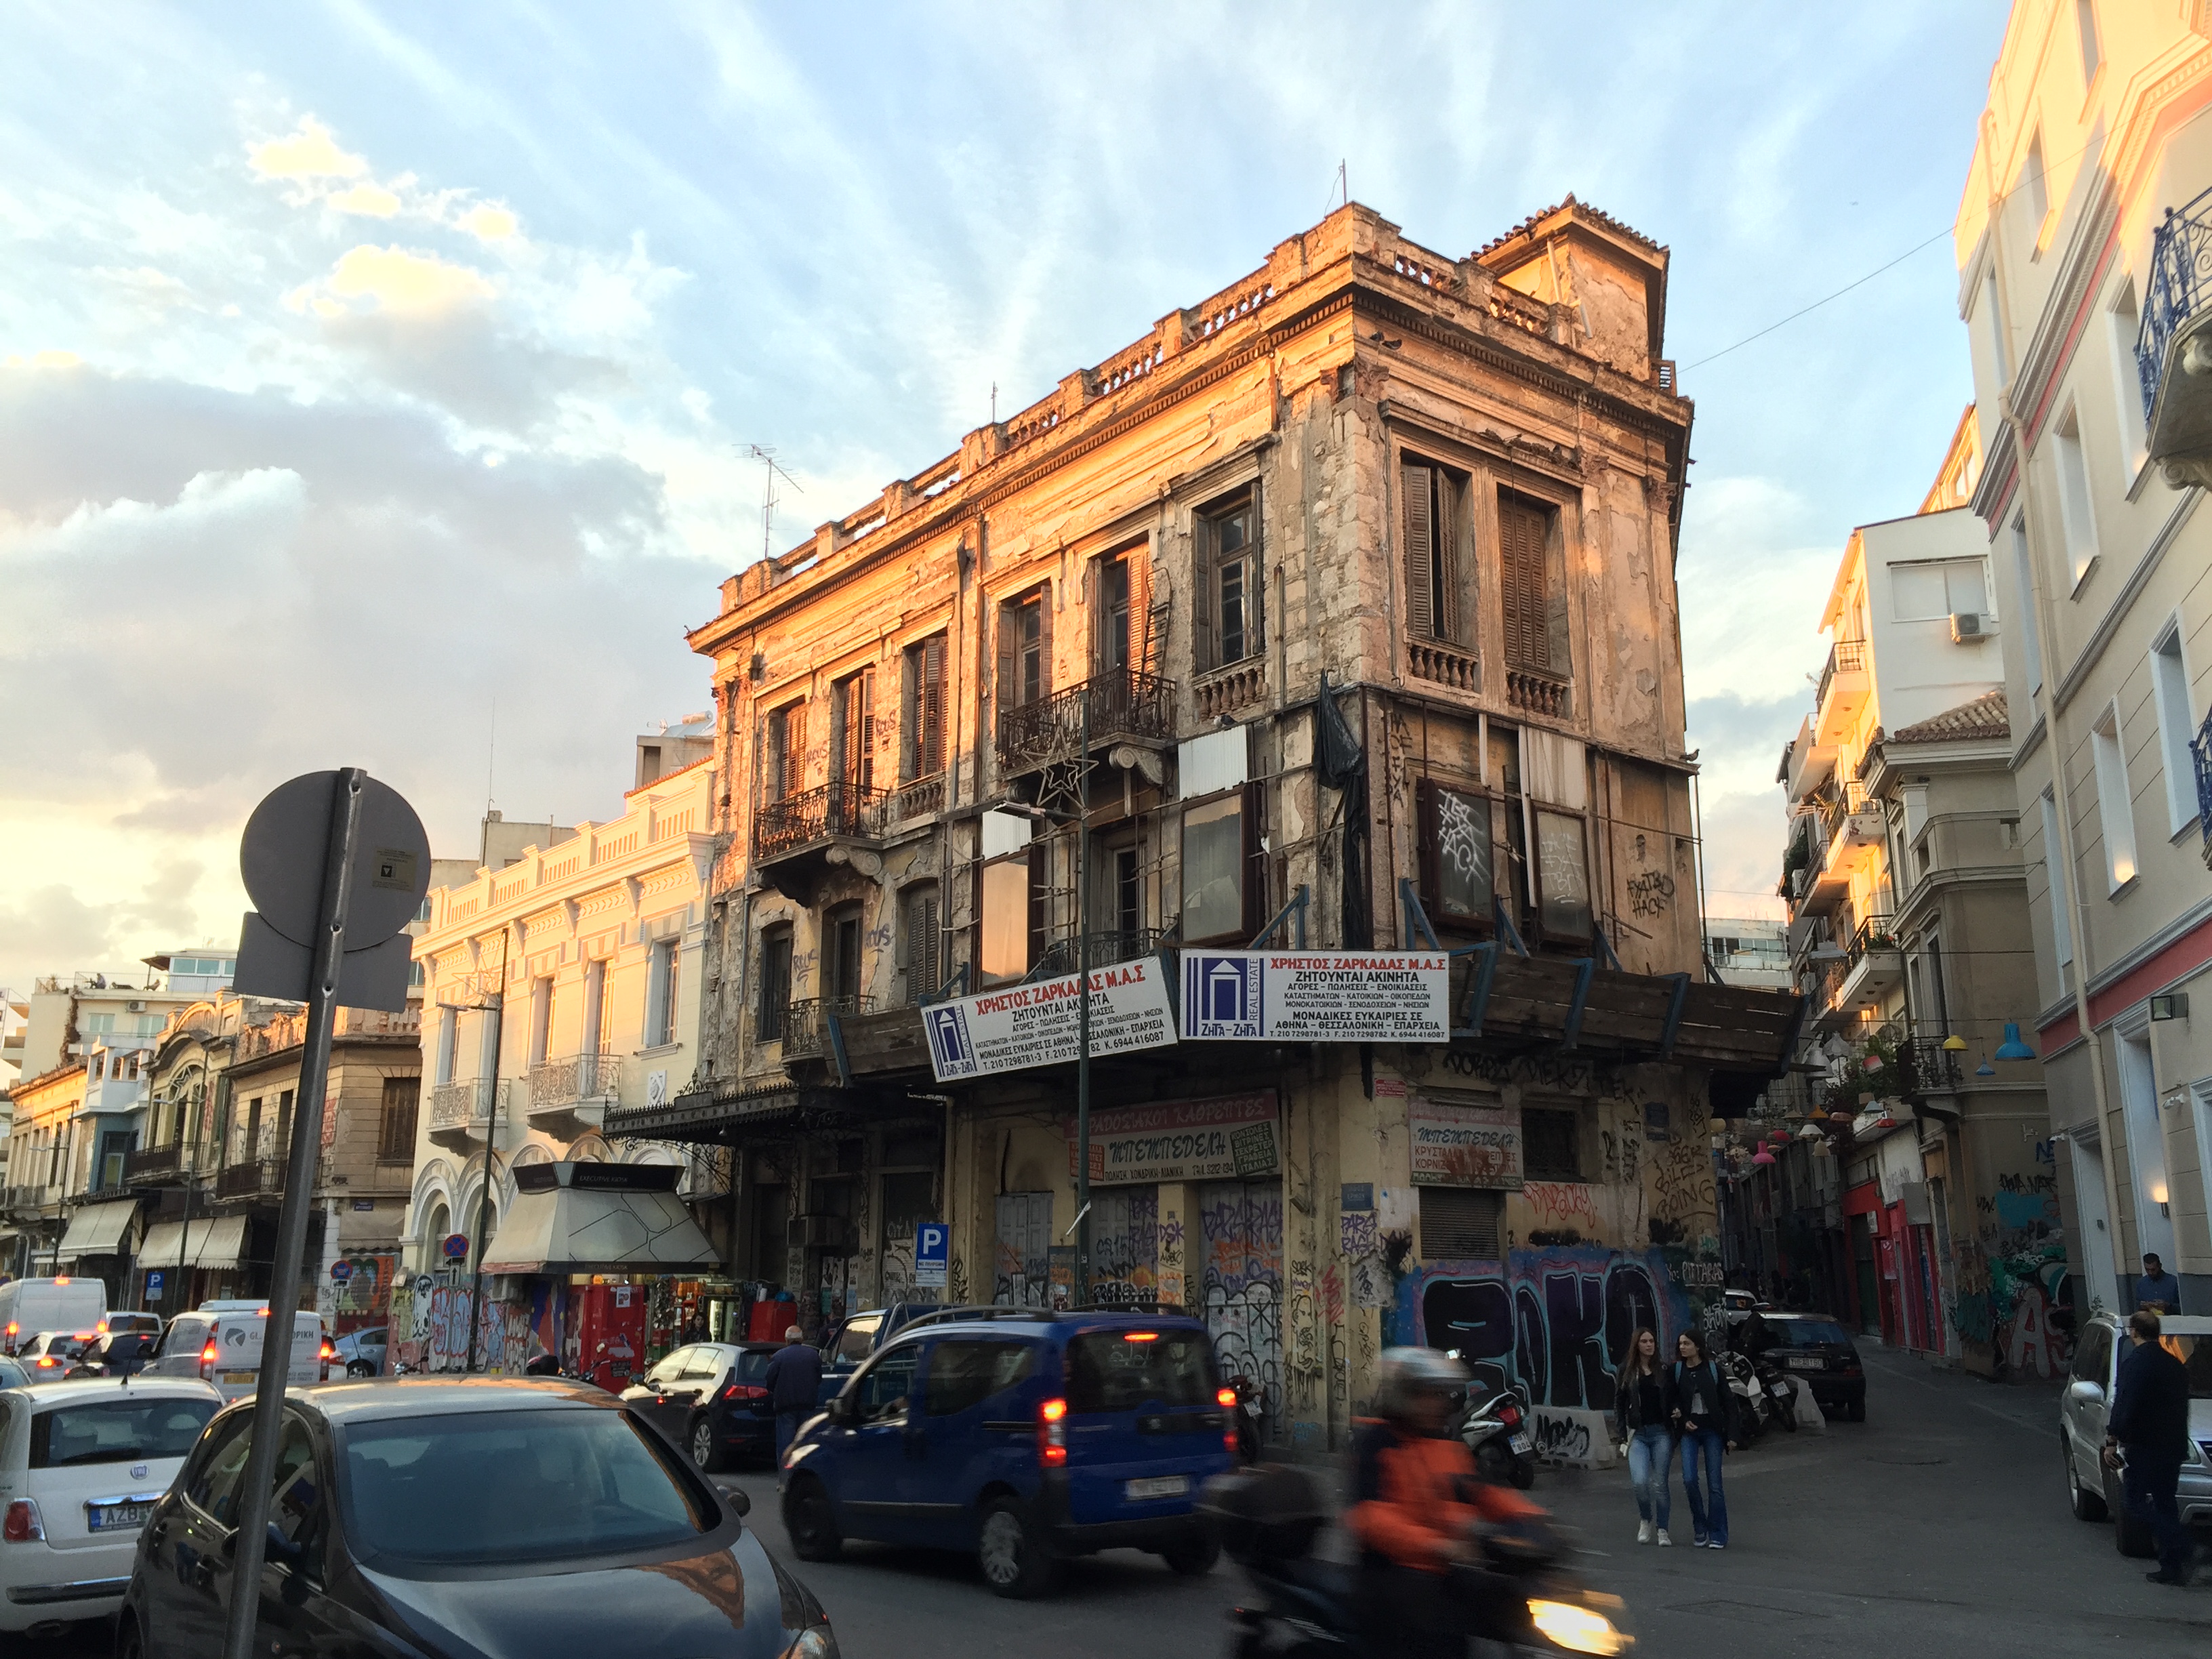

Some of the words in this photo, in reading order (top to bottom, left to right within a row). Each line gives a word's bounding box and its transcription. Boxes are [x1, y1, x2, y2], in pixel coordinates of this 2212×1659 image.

[1270, 958, 1330, 970] ΧΡΗΣΤΟΣ
[1334, 958, 1405, 970] ΖΑΡΚΑΔΑΣ
[1249, 958, 1258, 994] ESTATE
[1295, 971, 1363, 982] ΖΗΤΟΥΝΤΑΙ
[1366, 971, 1419, 983] ΑΚΙΝΗΤΑ
[975, 989, 1031, 1016] ΧΡΗΣΤΟΣ
[1012, 1001, 1065, 1023] ΖΗΤΟΥΝΤΑΙ
[1067, 992, 1110, 1015] ΑΚΗΤΑ
[1249, 996, 1258, 1021] REAL
[1012, 1021, 1035, 1032] ΑΓΟΡΕΣ
[1040, 1014, 1070, 1027] ΠΩΛΗΣΕΙΣ
[1076, 1005, 1115, 1020] ΕΚΙΑΣΕΙΣ
[1275, 1021, 1309, 1029] ΑΘΗΝΑ
[1318, 1021, 1384, 1030] ΘΕΣΣΑΛΟΝΙΚΗ
[1393, 1021, 1440, 1030] ΕΠΑΡΧΕΙΑ
[1292, 1011, 1353, 1021] ΜΟΝΑΔΙΚΕΣ
[1355, 1011, 1408, 1021] ΕΥΚΑΙΡΙΕΣ
[1410, 1012, 1423, 1021] ΣΕ
[975, 1038, 1008, 1049] ΚΑΤΑΣΤΗΜΑΤΩΝ
[979, 1046, 1013, 1060] ΜΟΝΑΔΙΚΕΣ
[1013, 1040, 1044, 1054] ΕΥΚΑΙΡΙΕΣ
[1044, 1039, 1052, 1048] ΣΕ
[1053, 1036, 1076, 1047] ΑΘΗΝΑ
[1084, 1025, 1125, 1042] ΣΣΑΛΟΝΙΚΗ
[1131, 1019, 1165, 1033] ΕΠΑΡΧΕΙΑ
[991, 1059, 1004, 1069] 210
[1054, 1048, 1067, 1059] 210
[1067, 1042, 1101, 1057] 72982
[1113, 1036, 1134, 1048] 6944
[1134, 1031, 1164, 1044] 416087
[1173, 1098, 1266, 1124] ΚΑΘΡΕΠΤΕΣ
[1231, 1122, 1269, 1141] ΚΟΝΣΟΛΕΣ
[1234, 1131, 1270, 1148] ΒΙΤΡΙΝΕΣ
[1235, 1139, 1273, 1156] ΣΕΚΡΕΤΕΡ
[1239, 1149, 1272, 1164] ΓΡΑΦΕΙΑ
[923, 1229, 941, 1254] P
